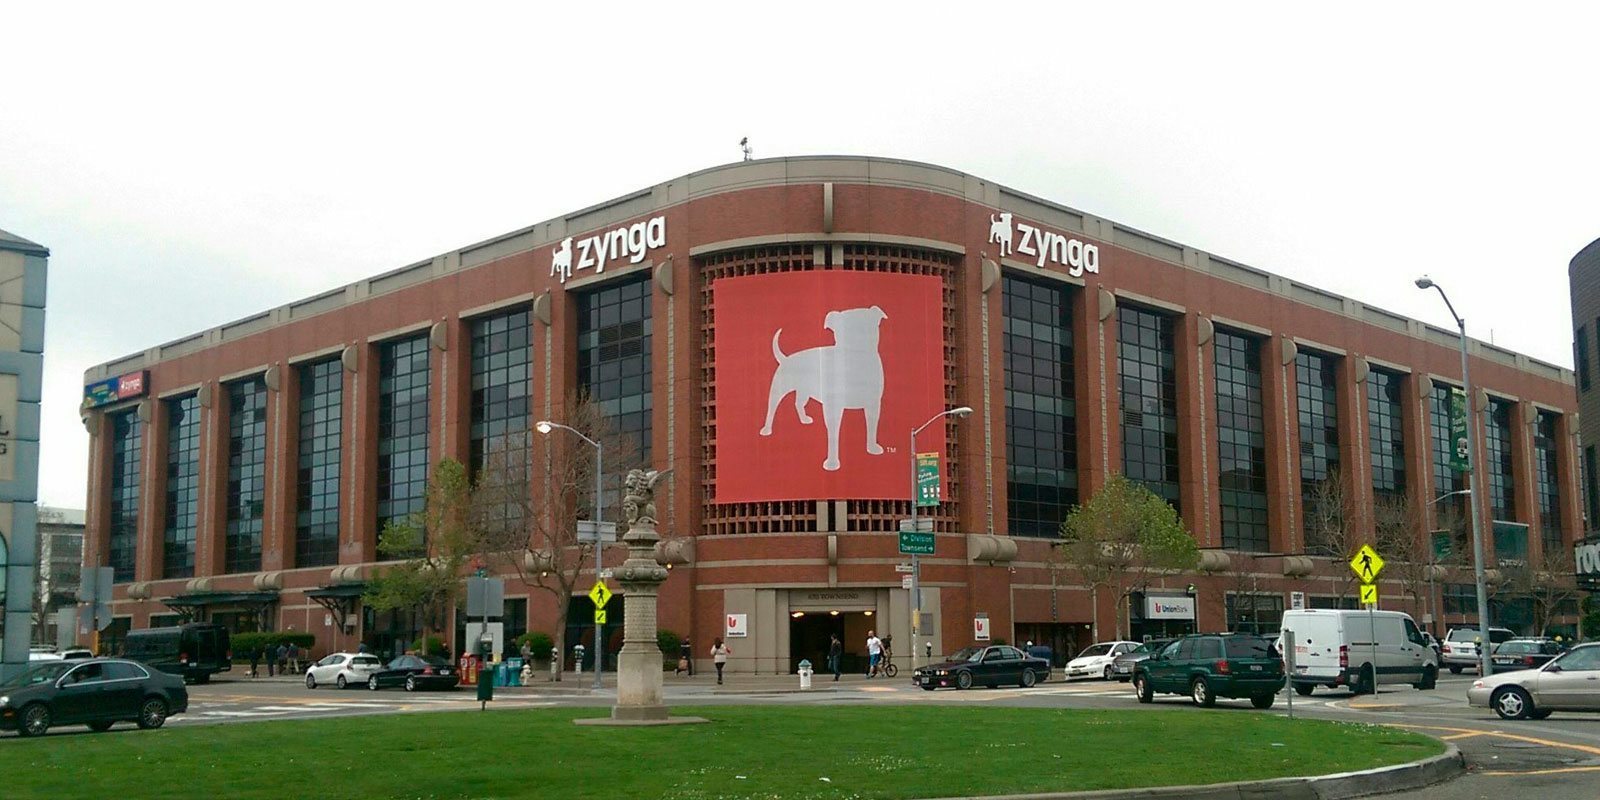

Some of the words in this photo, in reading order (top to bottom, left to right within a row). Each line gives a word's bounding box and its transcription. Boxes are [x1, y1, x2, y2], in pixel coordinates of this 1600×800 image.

[577, 216, 665, 273] zynga
[1017, 223, 1099, 277] zynga
[910, 534, 932, 543] Division
[901, 544, 927, 552] Townsend
[820, 592, 859, 600] TOWNSEND
[1161, 604, 1188, 613] UnionBank
